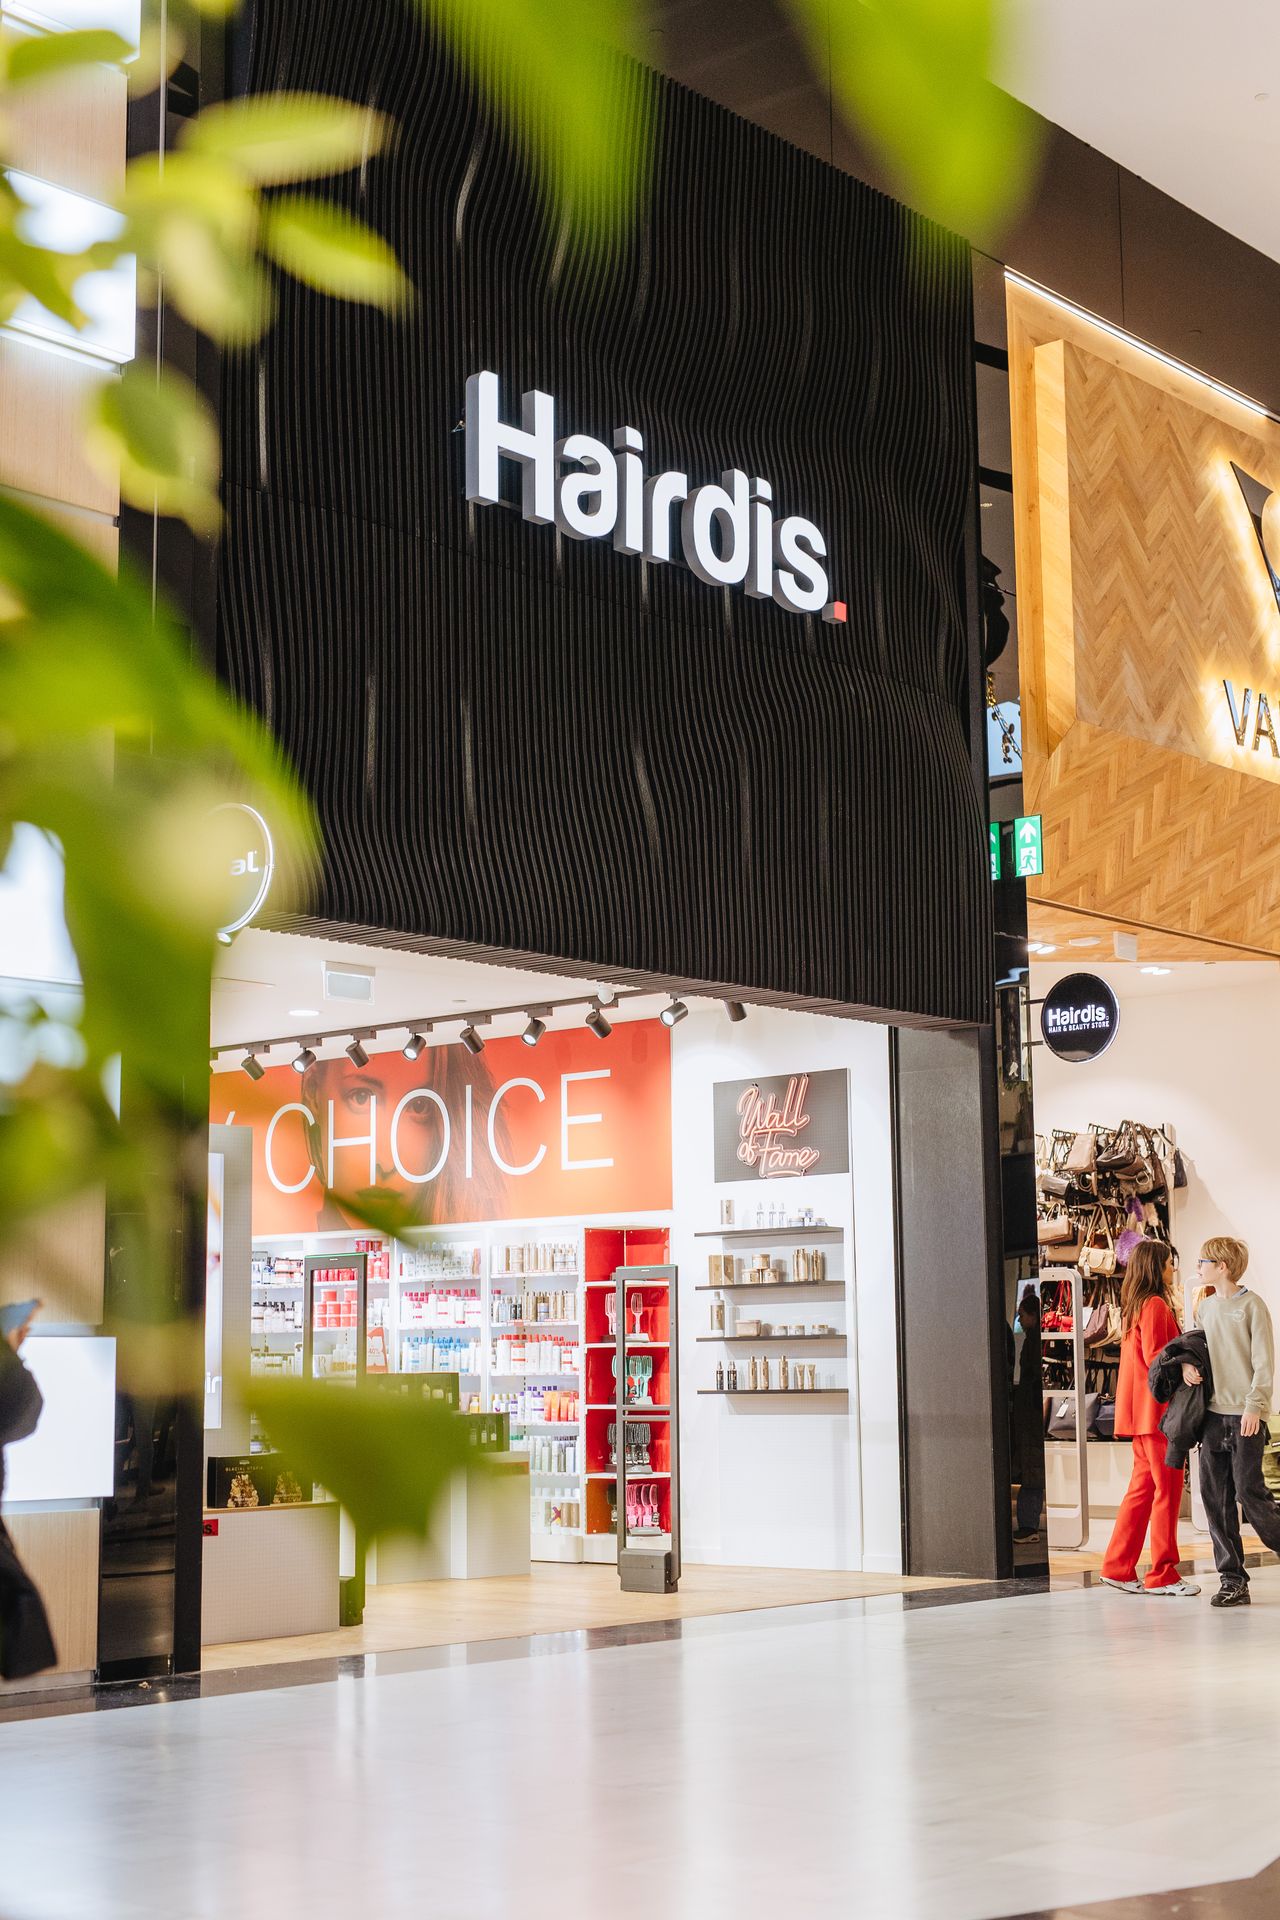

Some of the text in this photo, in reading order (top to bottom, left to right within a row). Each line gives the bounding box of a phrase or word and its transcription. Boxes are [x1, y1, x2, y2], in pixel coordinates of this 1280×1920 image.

[1223, 679, 1280, 758] VA
[1048, 1026, 1062, 1034] HAIR
[1069, 1023, 1090, 1031] BEAUTY
[1091, 1021, 1110, 1029] STORE
[265, 1069, 614, 1193] CHOICE
[738, 1076, 809, 1138] Wall
[754, 1129, 818, 1176] Fame
